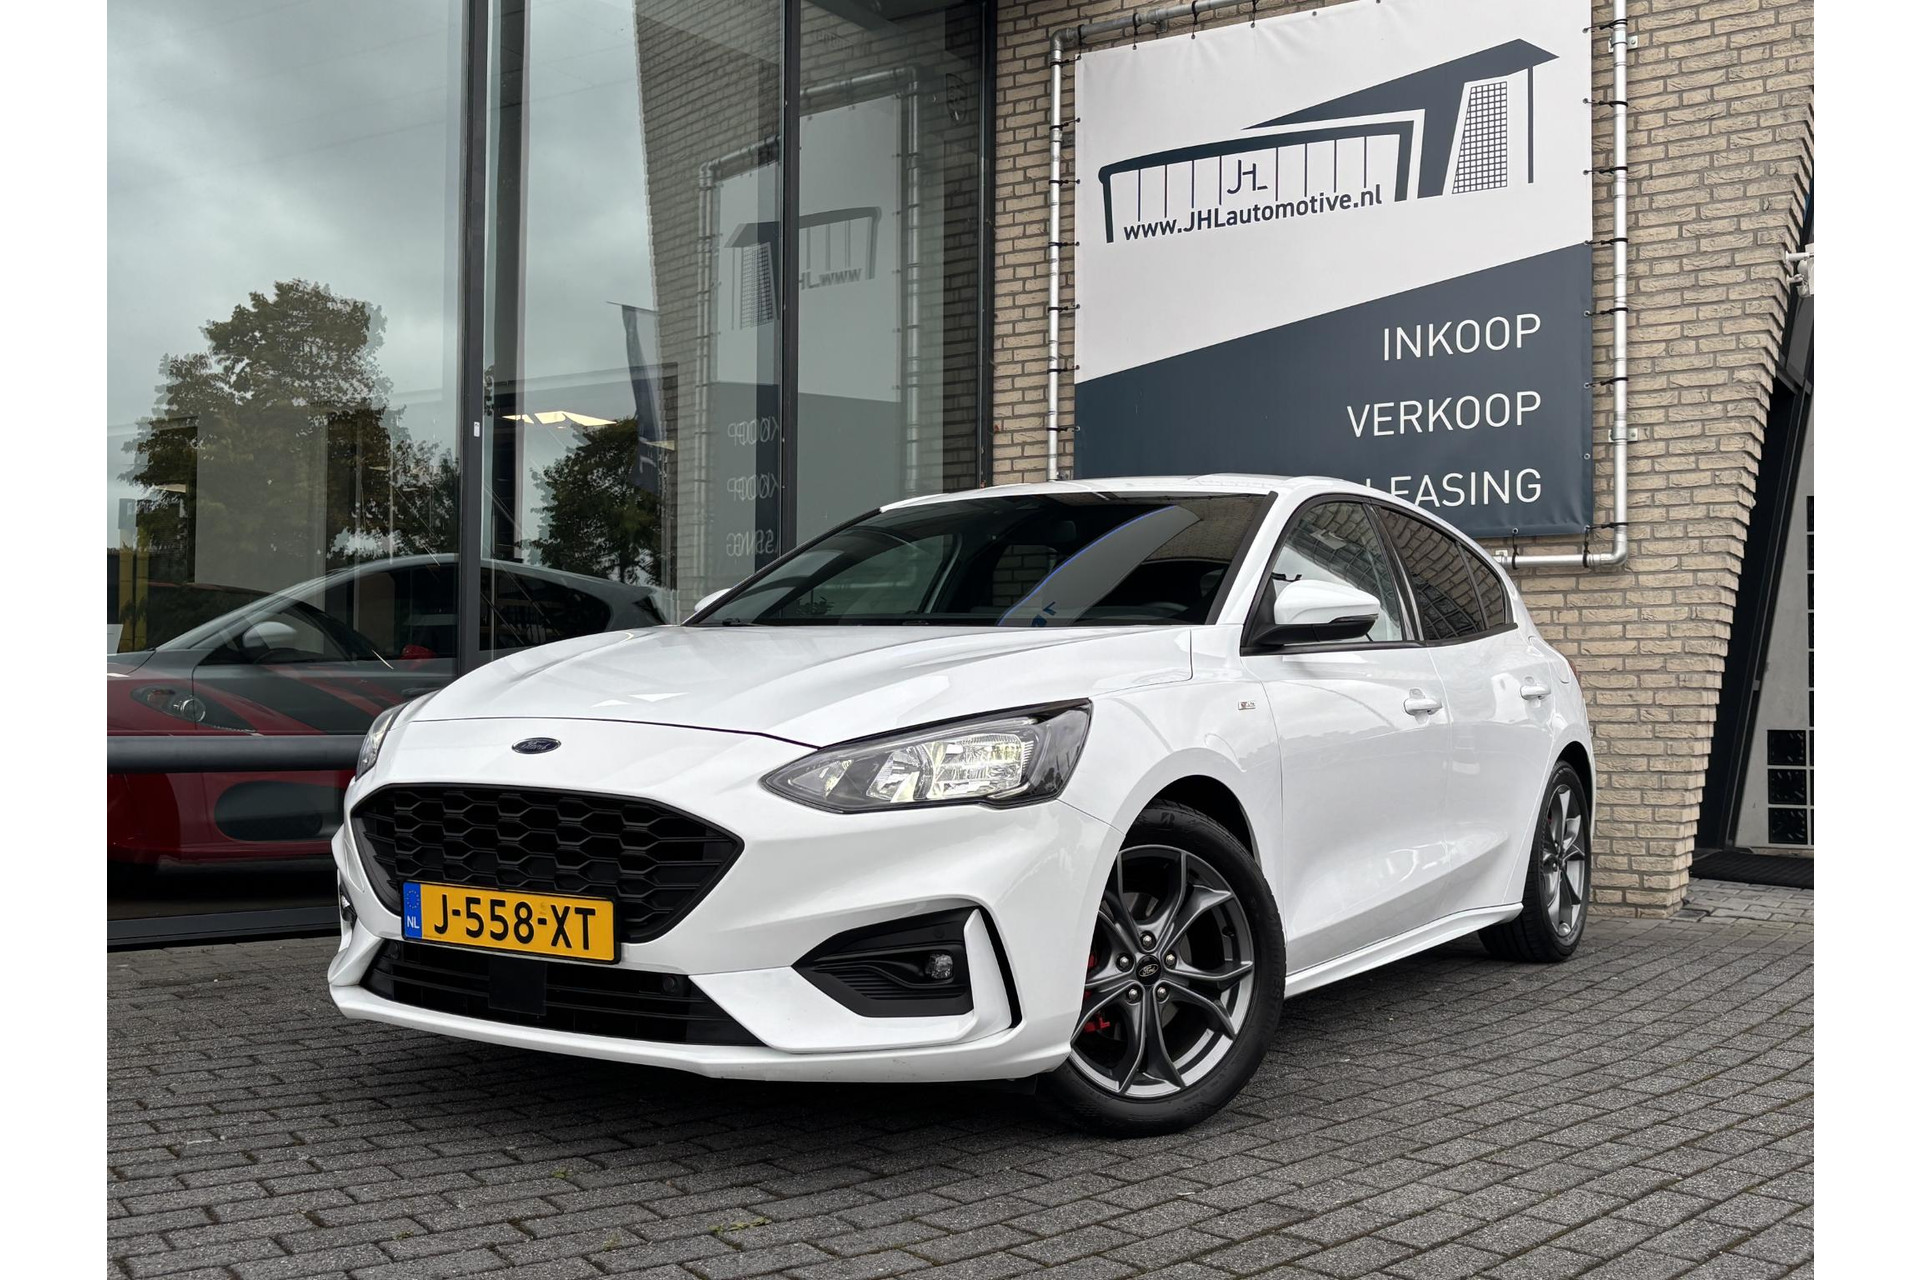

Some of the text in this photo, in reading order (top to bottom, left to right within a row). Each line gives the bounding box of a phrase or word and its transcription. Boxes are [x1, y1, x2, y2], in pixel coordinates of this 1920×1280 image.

[1123, 183, 1383, 241] www.JHLautomotive.nl
[1383, 313, 1541, 361] INKOOP
[1346, 390, 1542, 438] VERKOOP
[406, 916, 420, 929] NL
[433, 893, 597, 951] J-558-XT
